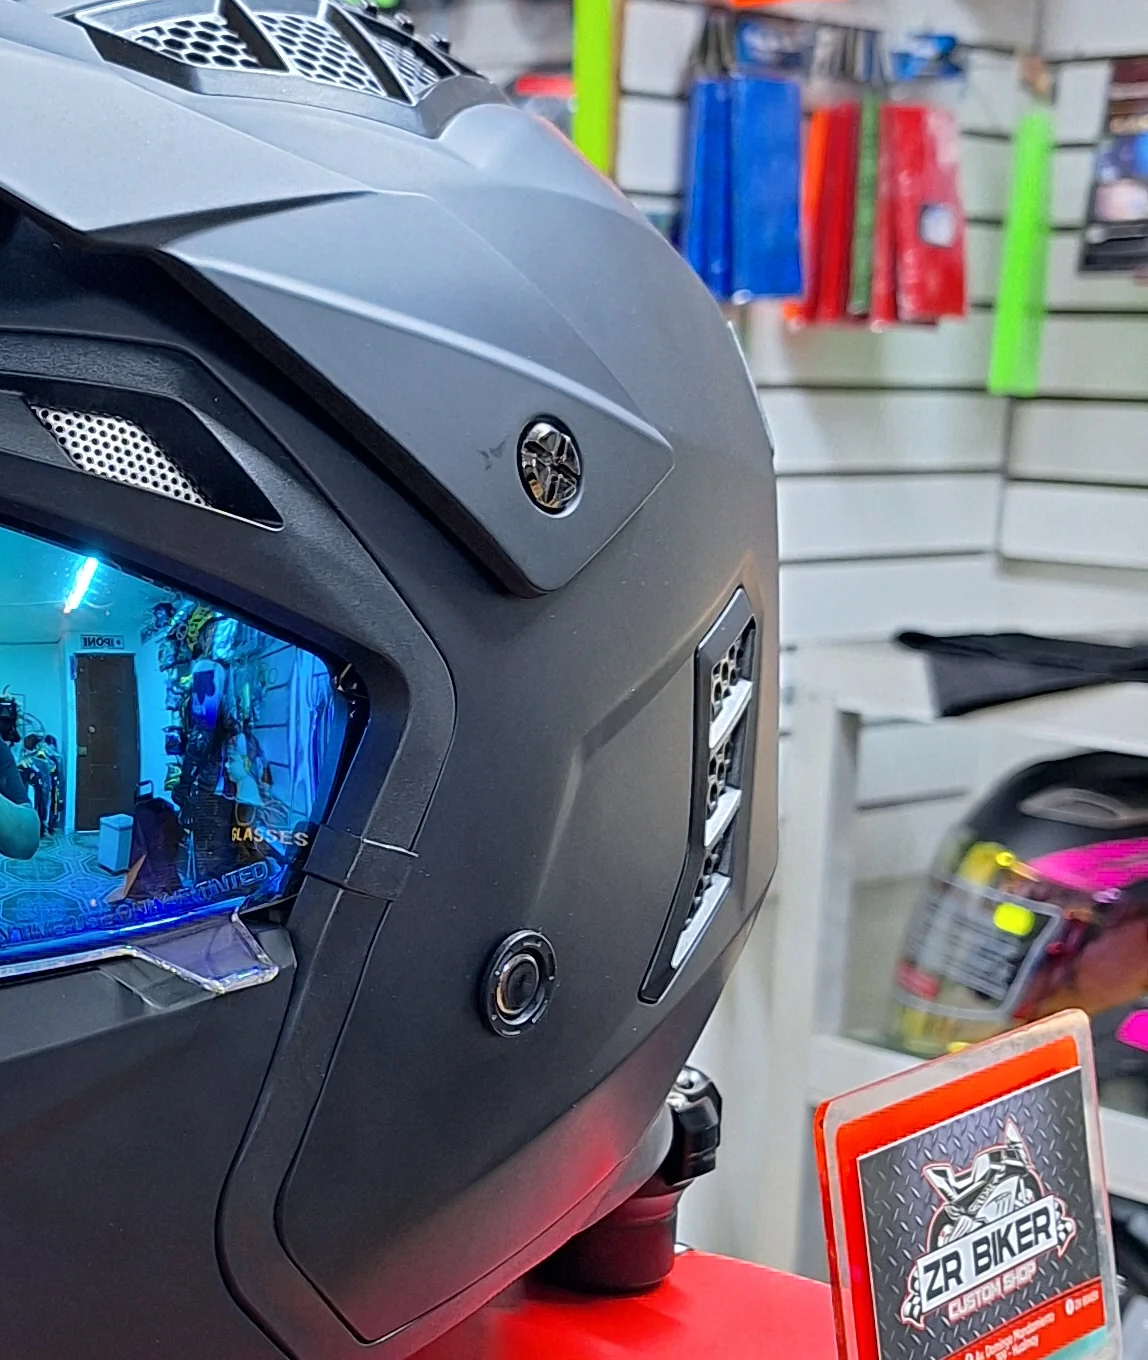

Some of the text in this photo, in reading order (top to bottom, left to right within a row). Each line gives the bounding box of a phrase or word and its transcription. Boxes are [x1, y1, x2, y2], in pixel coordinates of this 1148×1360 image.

[232, 827, 309, 847] GLASSES
[923, 1206, 1052, 1301] ZR BIKER
[948, 1261, 1037, 1321] CUSTOM SHOP
